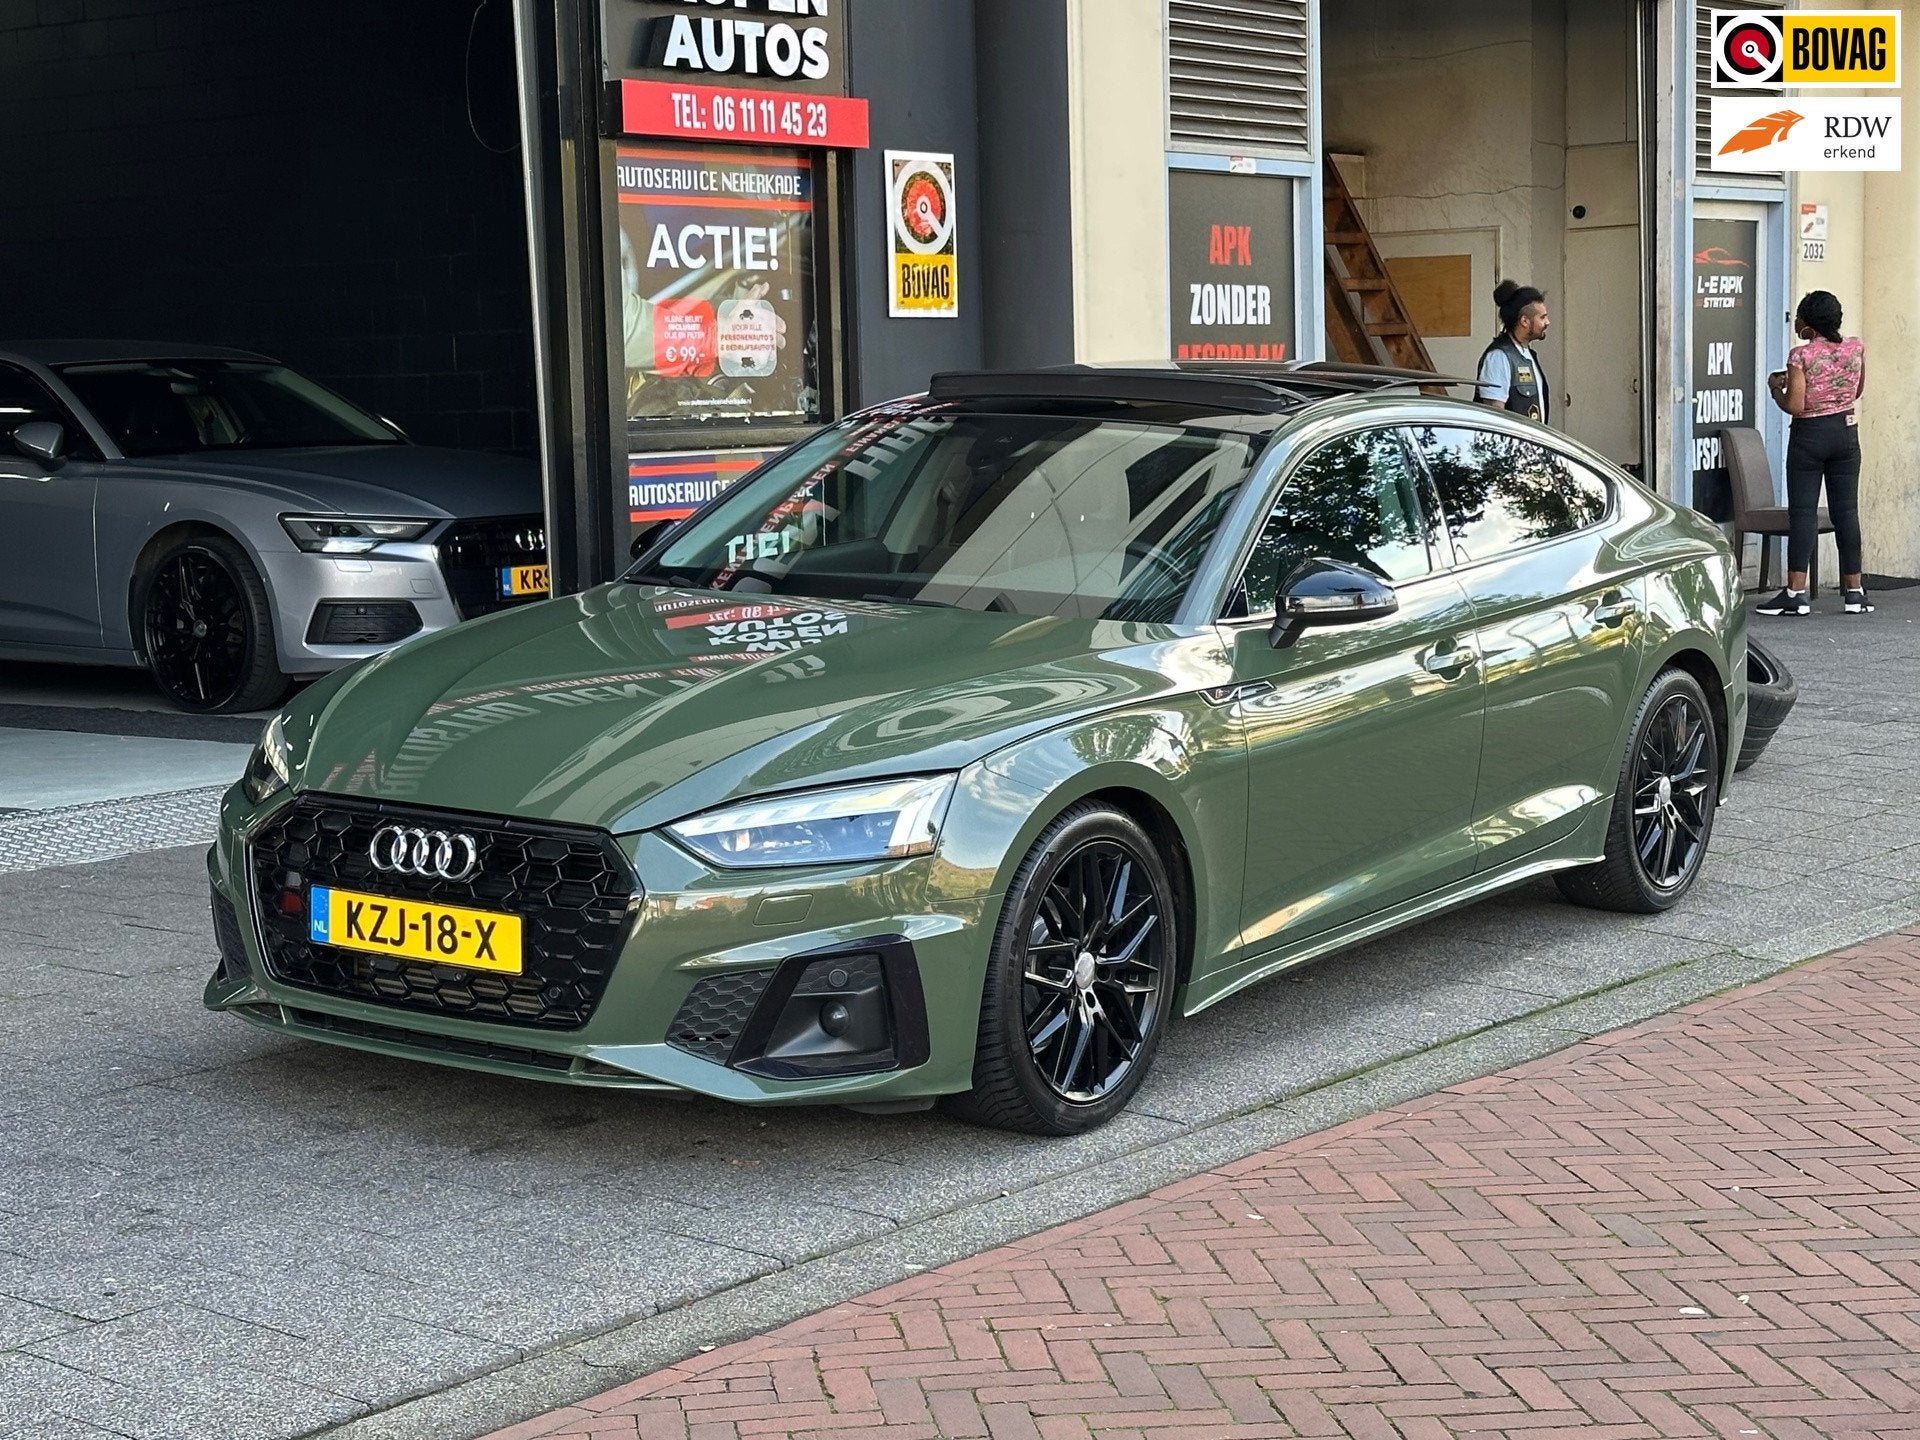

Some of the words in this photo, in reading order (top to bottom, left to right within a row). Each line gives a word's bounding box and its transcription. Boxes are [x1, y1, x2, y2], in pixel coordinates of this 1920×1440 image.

[662, 13, 831, 80] AUTOS
[671, 91, 707, 129] TEL:
[712, 94, 735, 131] 06
[739, 97, 756, 133] 11
[759, 98, 776, 134] 11
[780, 100, 802, 136] 45
[806, 101, 828, 138] 23
[616, 165, 719, 192] AUTOSERVICE
[721, 171, 802, 196] NEHERKADE
[646, 223, 780, 272] ACTIE!
[1208, 223, 1252, 266] APK
[1803, 242, 1825, 260] 2032
[901, 263, 950, 300] BOVAG
[1719, 275, 1744, 294] APK
[1189, 283, 1271, 325] ZONDER
[1703, 297, 1736, 309] STATION
[1707, 341, 1733, 376] APK
[1695, 388, 1744, 424] ZONDER
[313, 920, 328, 934] NL
[346, 899, 498, 962] KZJ-18-X
